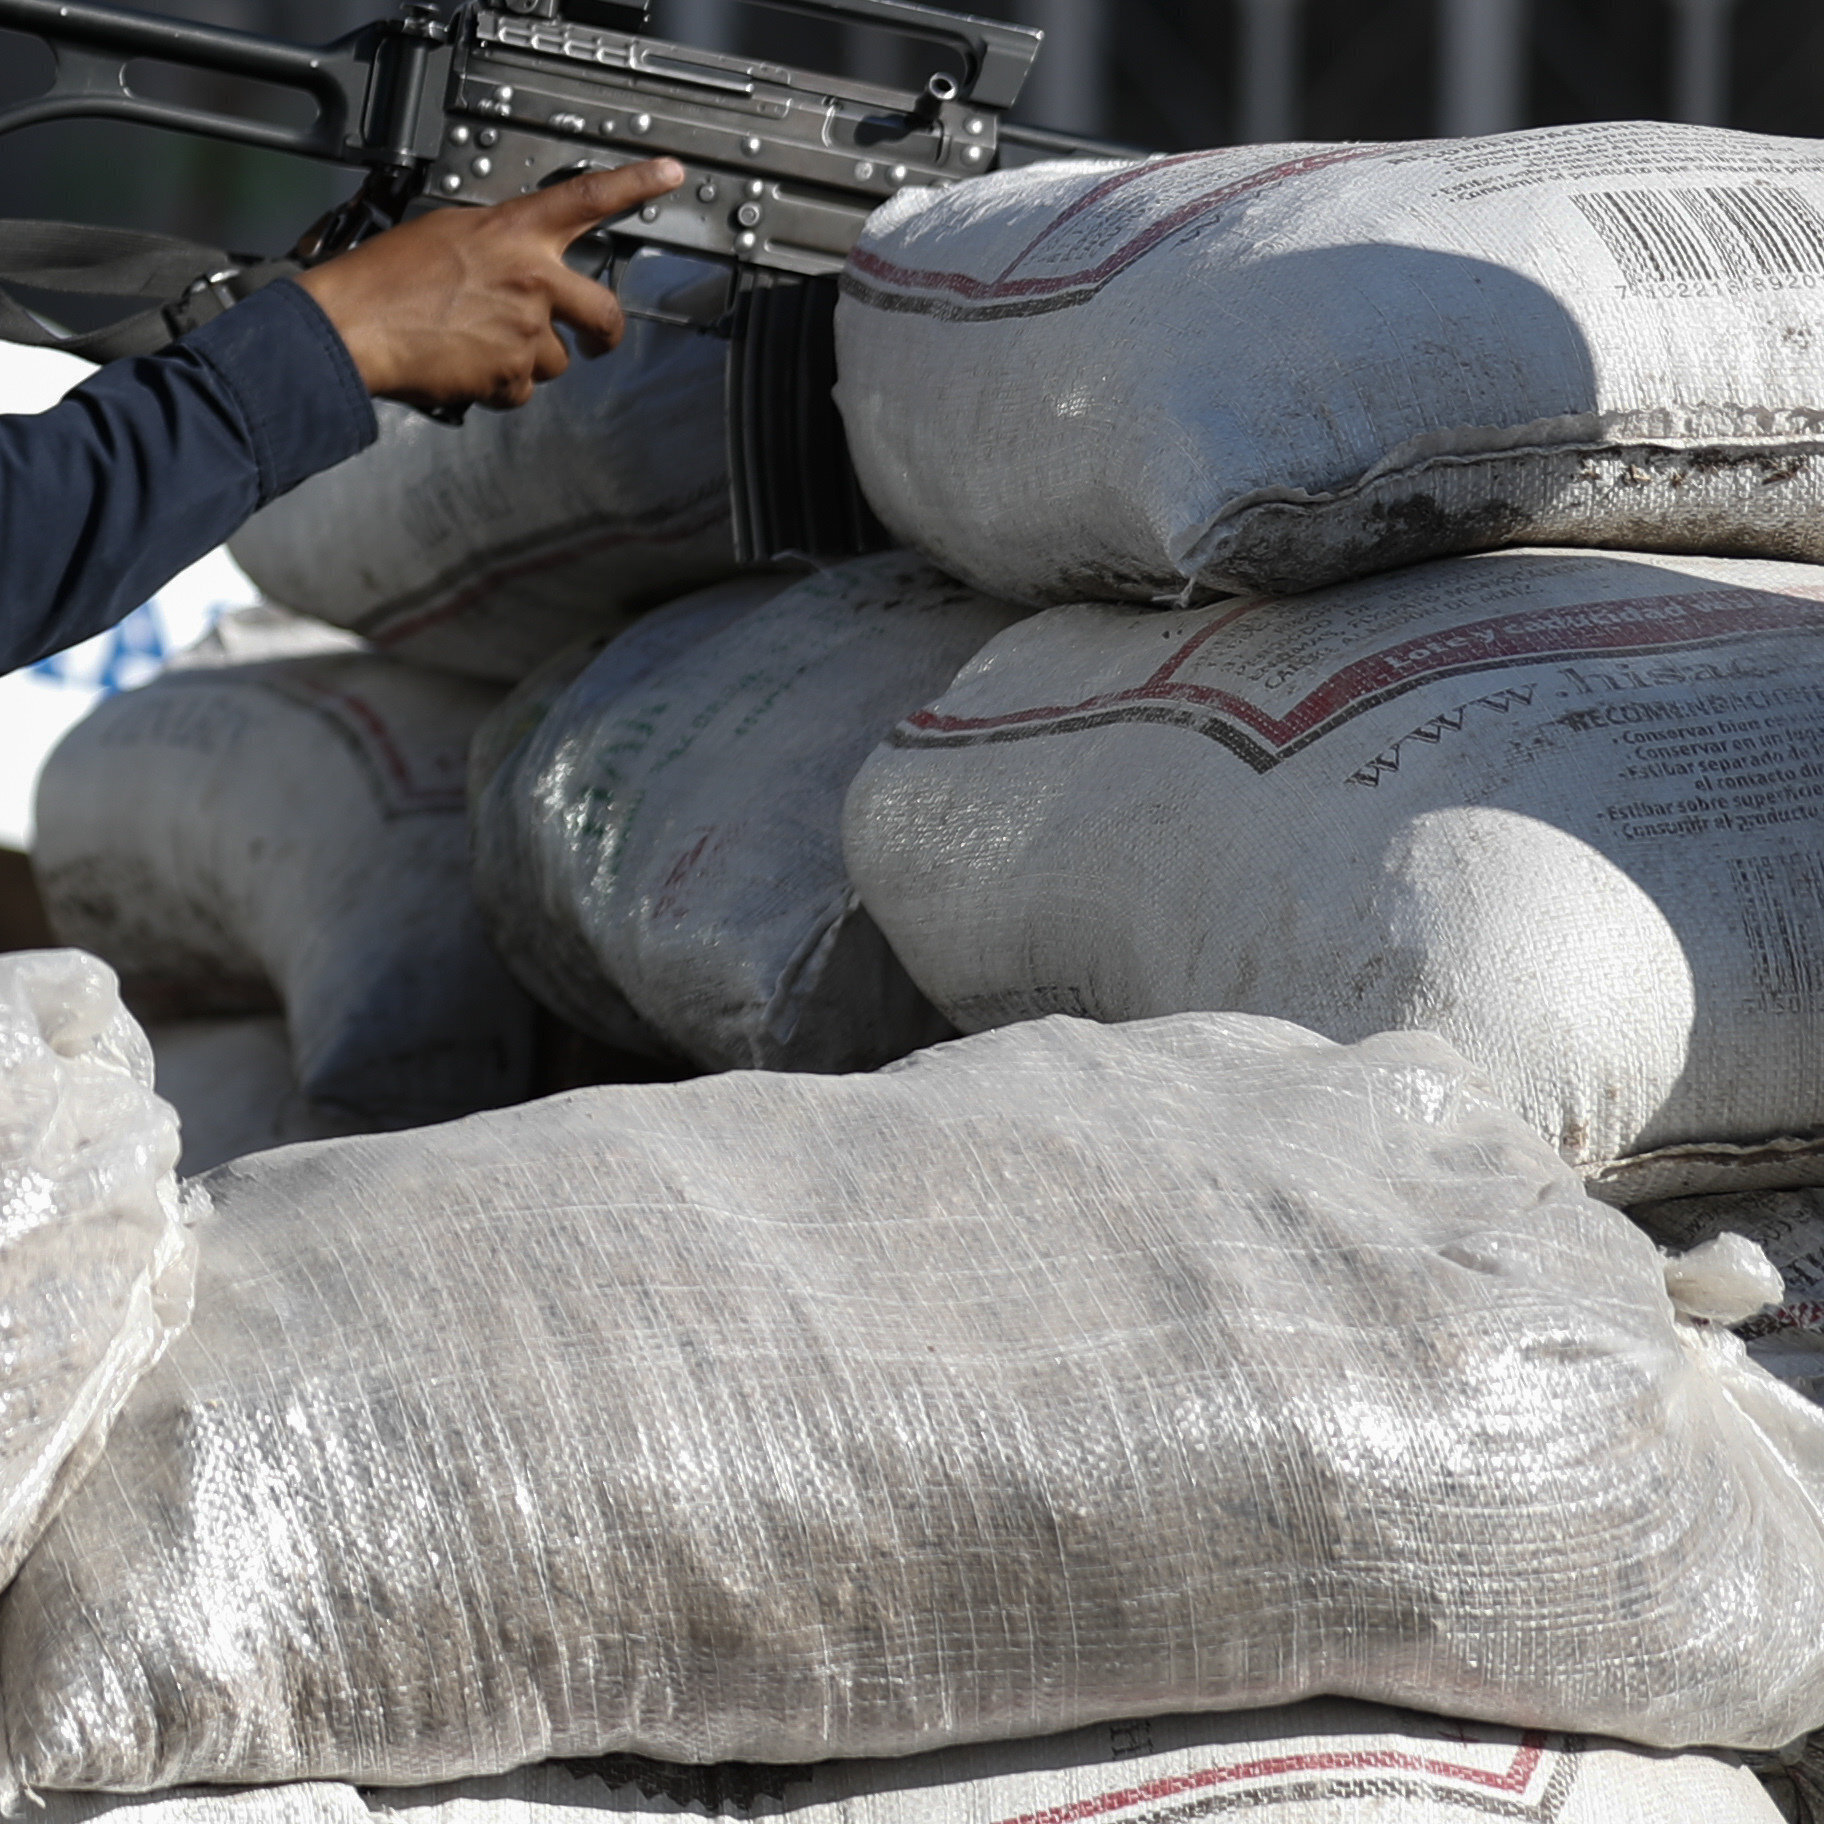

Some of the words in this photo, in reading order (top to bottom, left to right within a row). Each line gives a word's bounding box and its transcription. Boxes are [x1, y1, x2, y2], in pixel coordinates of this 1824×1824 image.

[1622, 723, 1716, 745] Conservar
[1718, 718, 1761, 735] bien
[1635, 738, 1729, 761] Conservar
[1732, 737, 1755, 752] en
[1698, 749, 1785, 775] separado
[1694, 777, 1713, 792] el
[1716, 766, 1797, 789] contacto
[1606, 801, 1674, 822] Estibar
[1677, 794, 1729, 814] sobre
[1732, 783, 1824, 808] superficie
